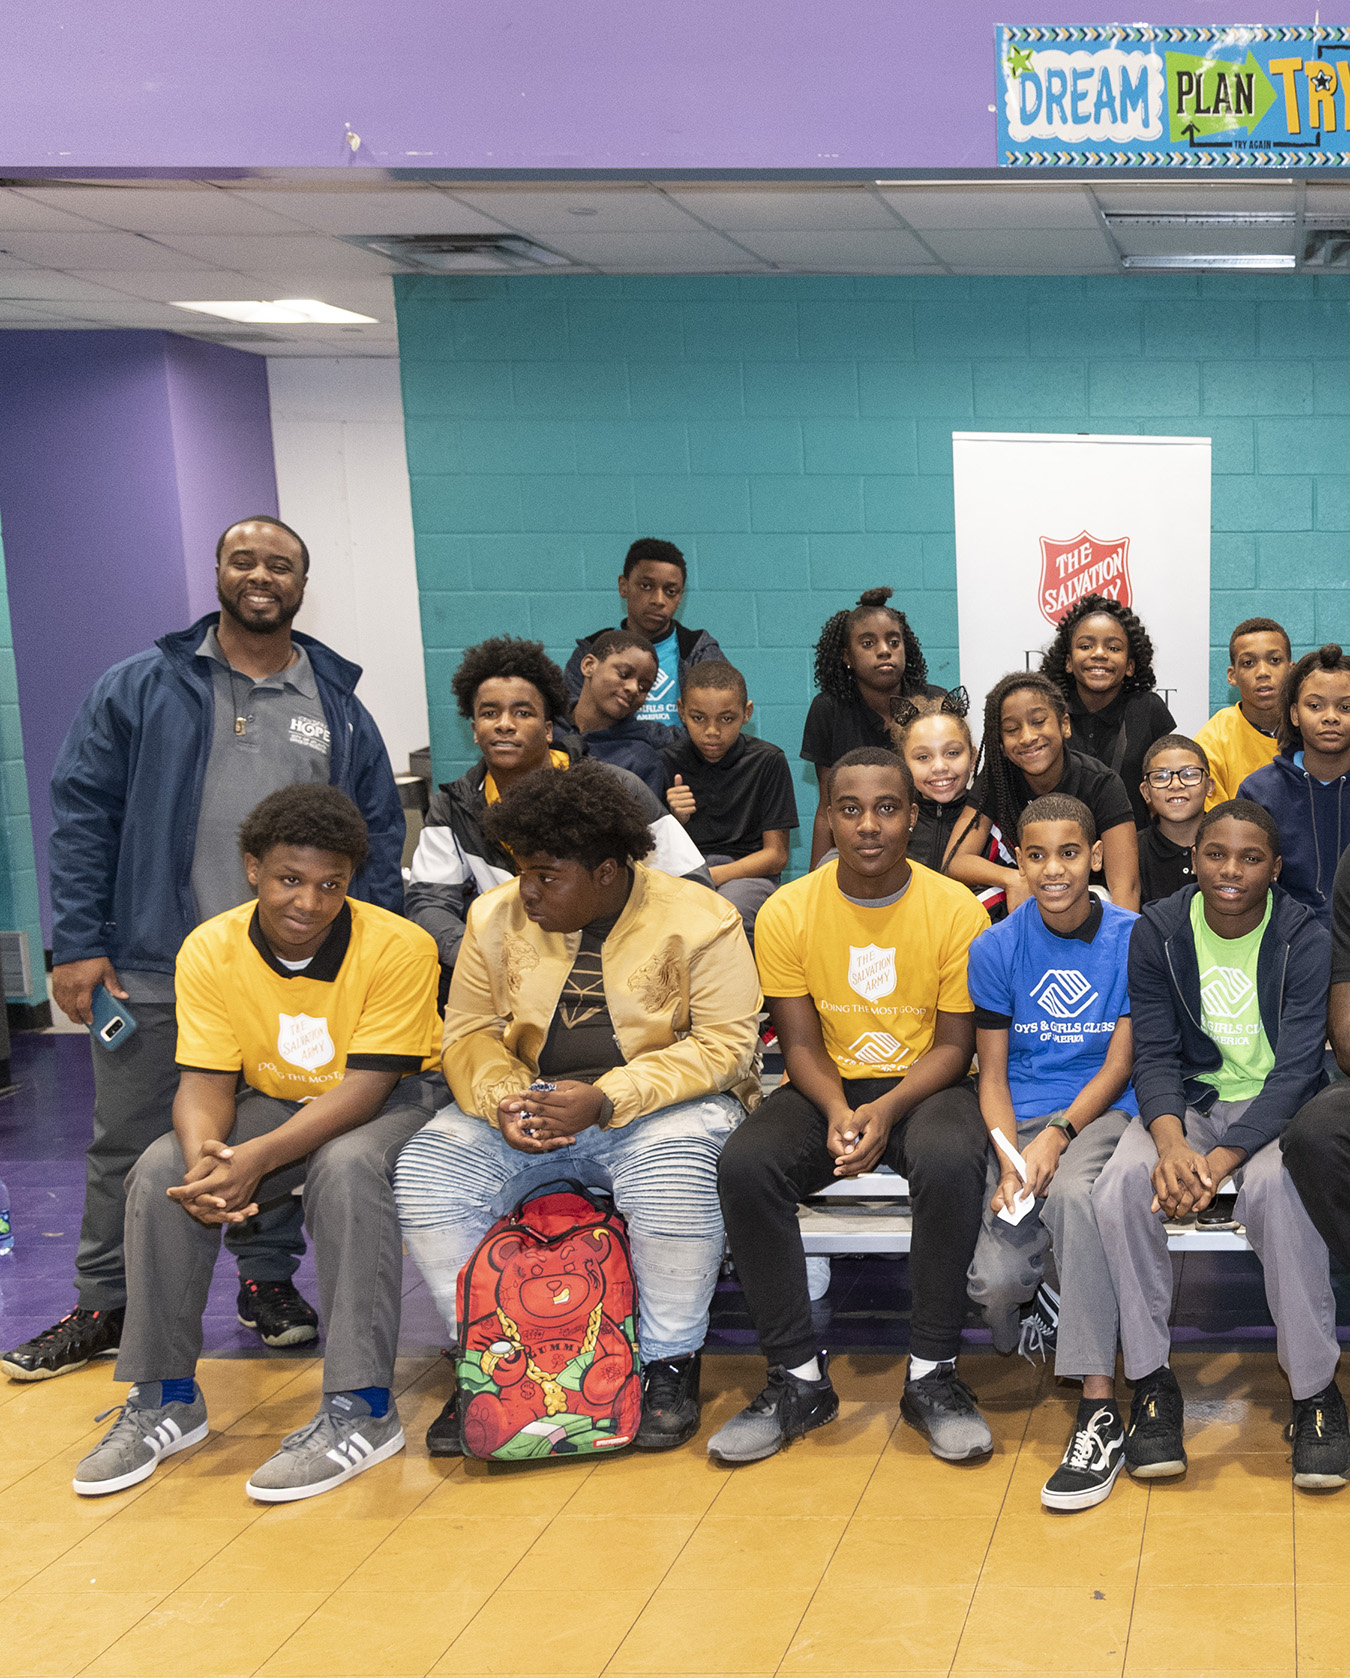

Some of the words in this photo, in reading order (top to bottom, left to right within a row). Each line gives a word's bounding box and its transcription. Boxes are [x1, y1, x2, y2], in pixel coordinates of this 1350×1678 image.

[1019, 64, 1150, 129] DREAM
[1177, 71, 1255, 117] PLAN
[1234, 140, 1248, 150] TRY
[1249, 140, 1271, 150] AGAIN
[1056, 542, 1093, 579] THE
[1044, 547, 1123, 613] SALVATION
[290, 717, 331, 742] HOPE
[852, 954, 892, 985] SALVATION
[856, 950, 875, 968] THE
[865, 969, 890, 994] ARMY
[290, 1020, 305, 1036] THE
[1040, 1020, 1050, 1032] &
[1040, 1031, 1053, 1042] OF
[1207, 1020, 1243, 1035] GIRLS
[283, 1026, 325, 1056] SALVATION
[302, 1040, 325, 1063] ARMY
[287, 1073, 307, 1083] THE
[308, 1070, 340, 1084] MOST
